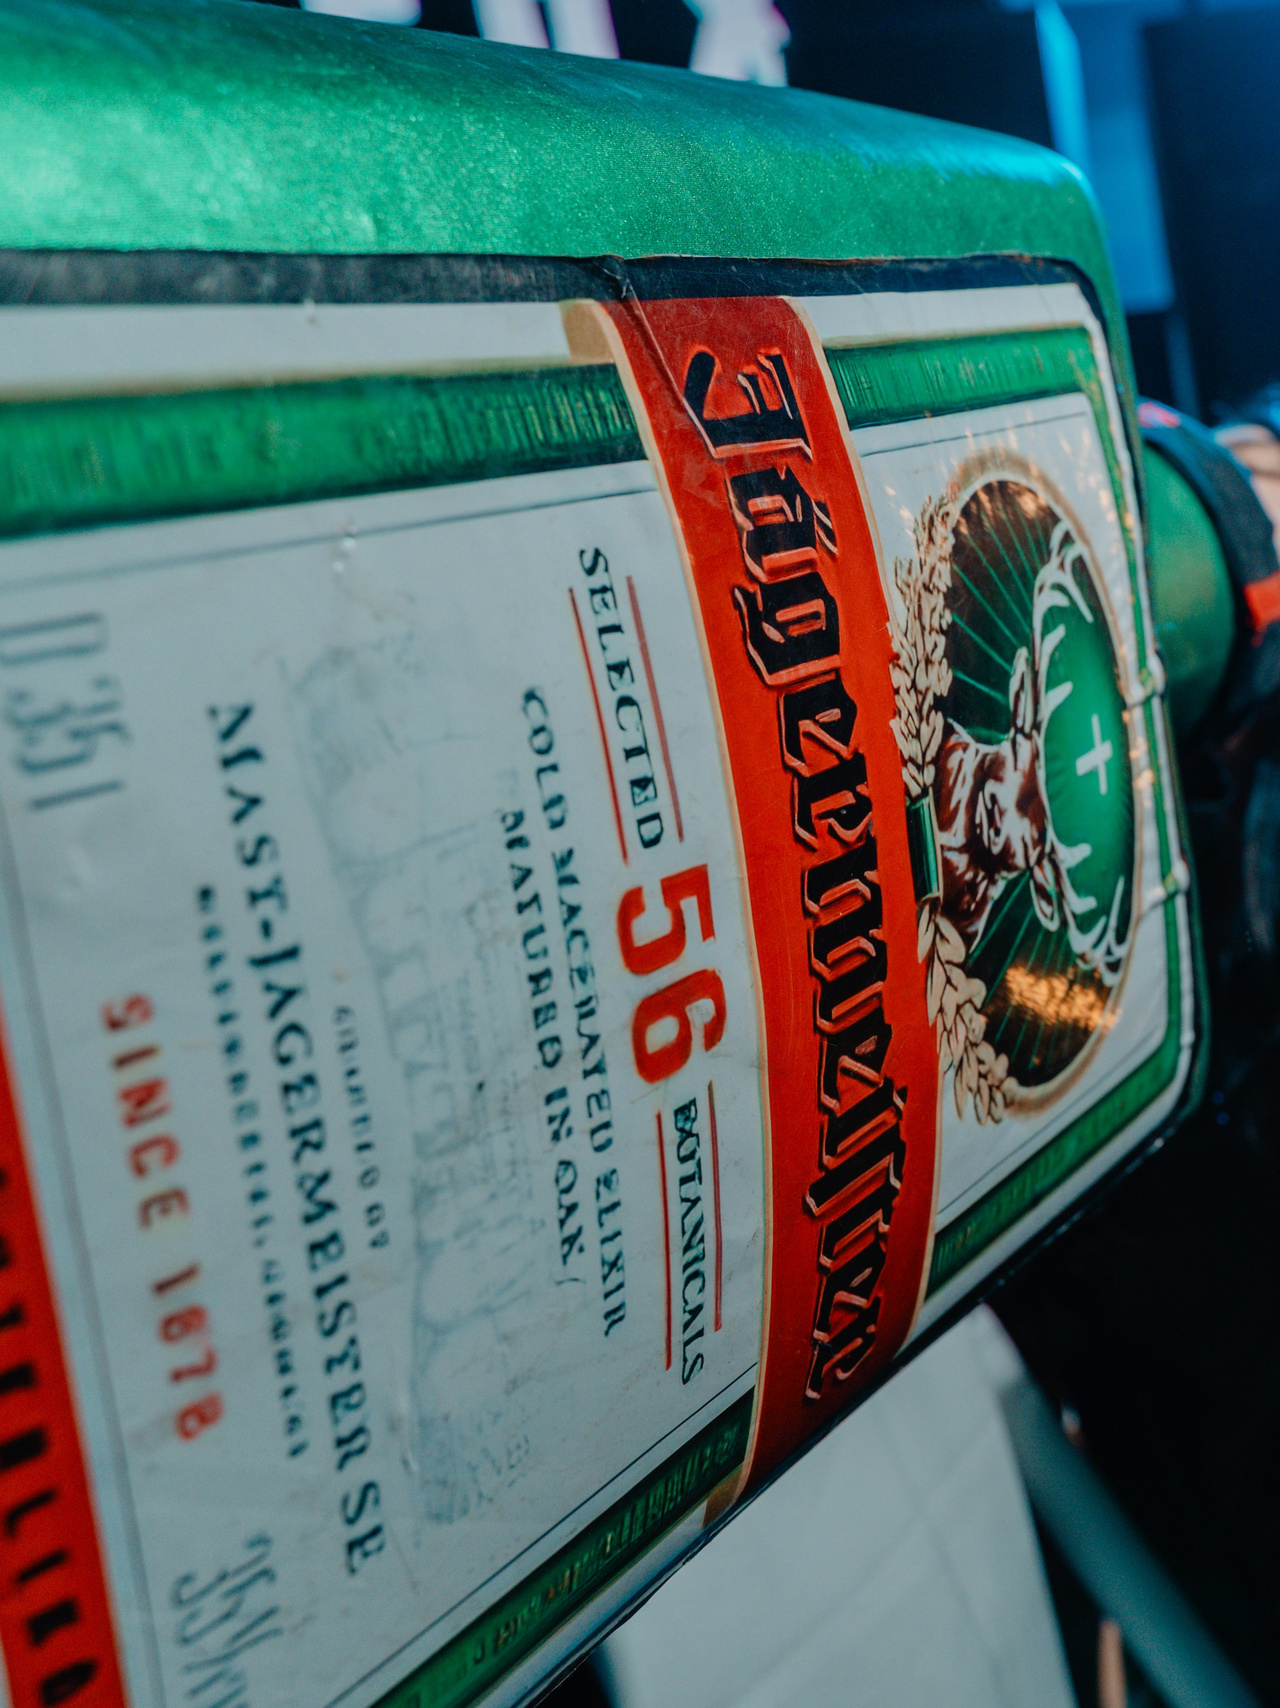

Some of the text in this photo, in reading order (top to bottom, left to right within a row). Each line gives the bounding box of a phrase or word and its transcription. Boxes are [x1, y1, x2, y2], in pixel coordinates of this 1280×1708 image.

[102, 994, 190, 1230] SINCE
[501, 808, 586, 1267] MATURED IN OAK
[521, 685, 628, 1338] COLD MACERATED ELIXIR
[579, 546, 727, 1386] SELECTED 56 BOTANICALS
[340, 1481, 388, 1577] SE
